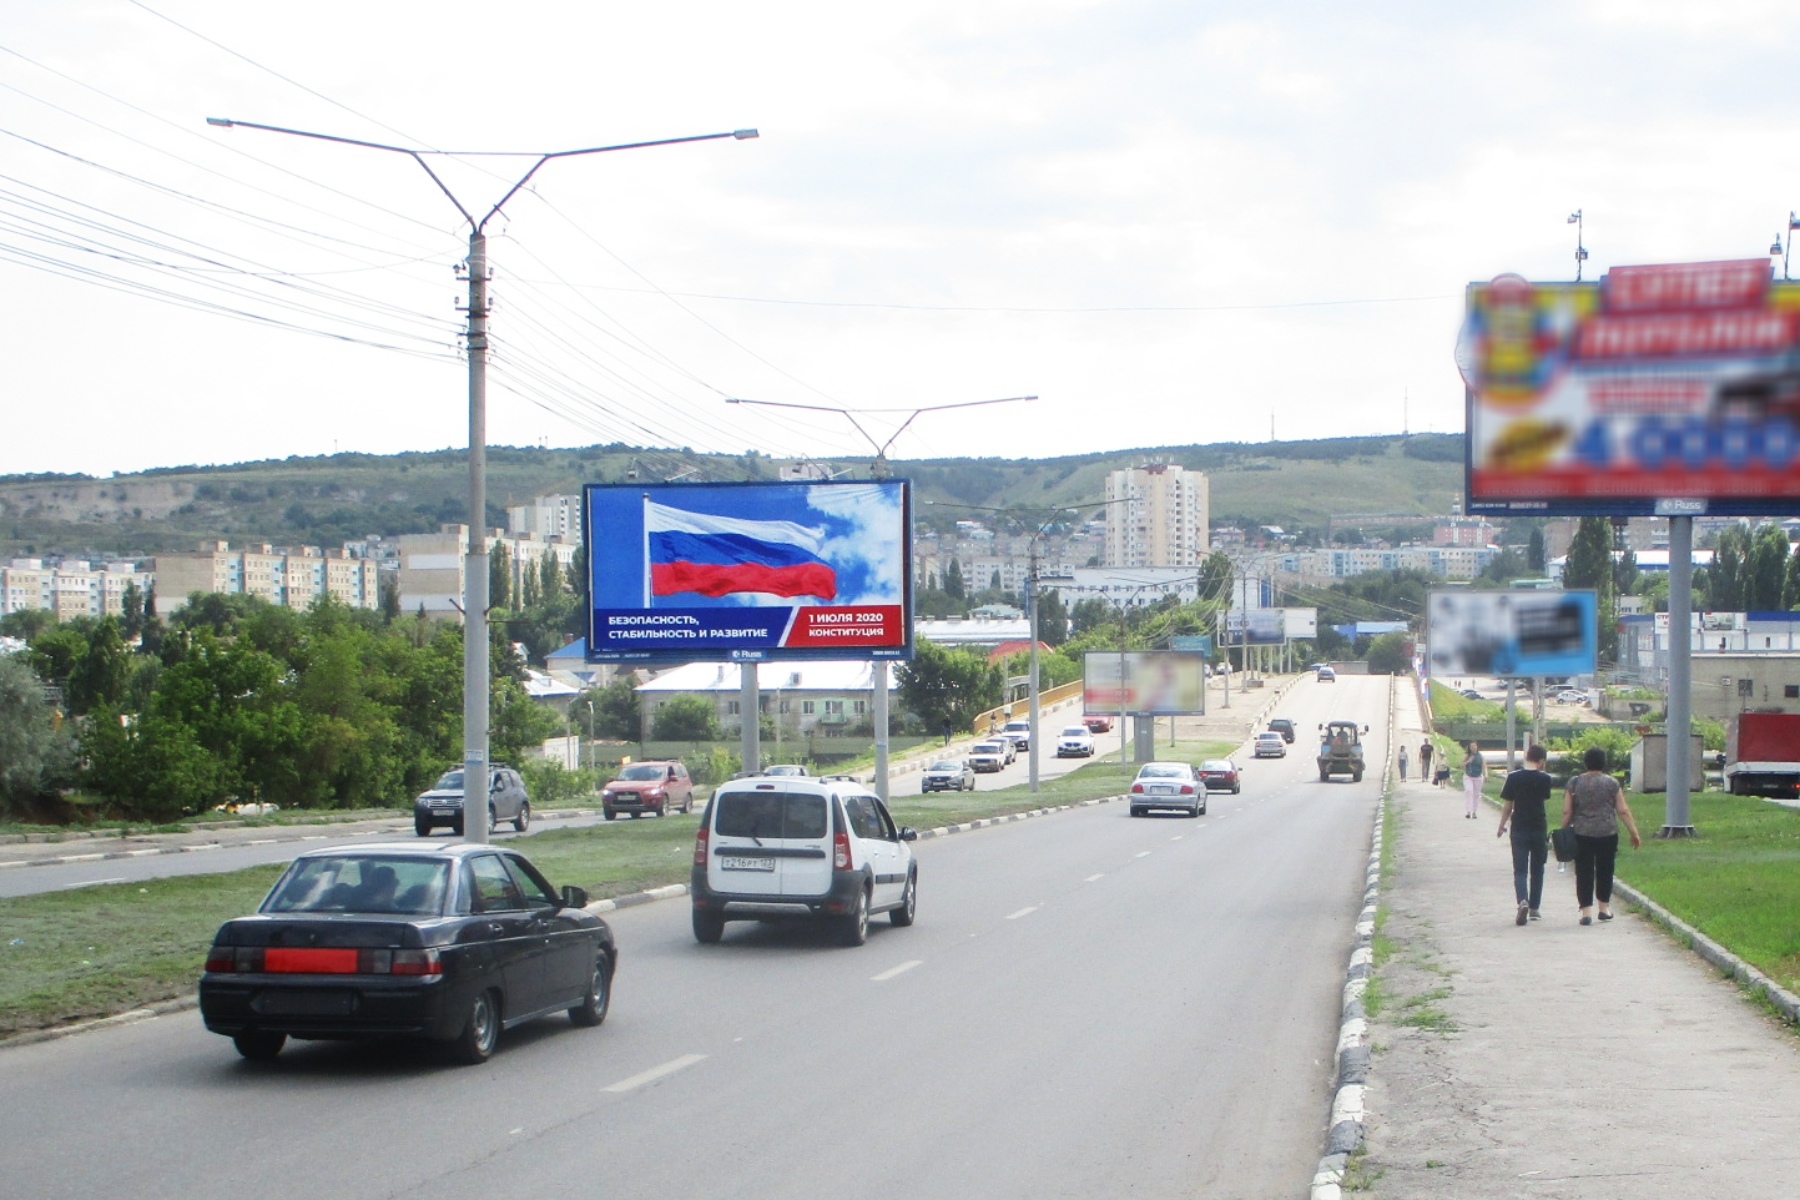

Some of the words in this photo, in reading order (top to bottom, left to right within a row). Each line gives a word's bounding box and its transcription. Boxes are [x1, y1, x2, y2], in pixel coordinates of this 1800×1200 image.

[1675, 499, 1701, 510] Russ
[608, 615, 700, 626] БЕЗОПАСНОСТЬ,
[808, 614, 814, 623] 1
[816, 613, 853, 623] ИЮЛЯ
[856, 613, 884, 622] 2020
[608, 629, 697, 639] СТАБИЛЬНОСТЬ
[699, 629, 708, 638] И
[710, 628, 768, 638] РАЗВИТИЕ
[808, 627, 884, 637] КОНСТИТУЦИЯ
